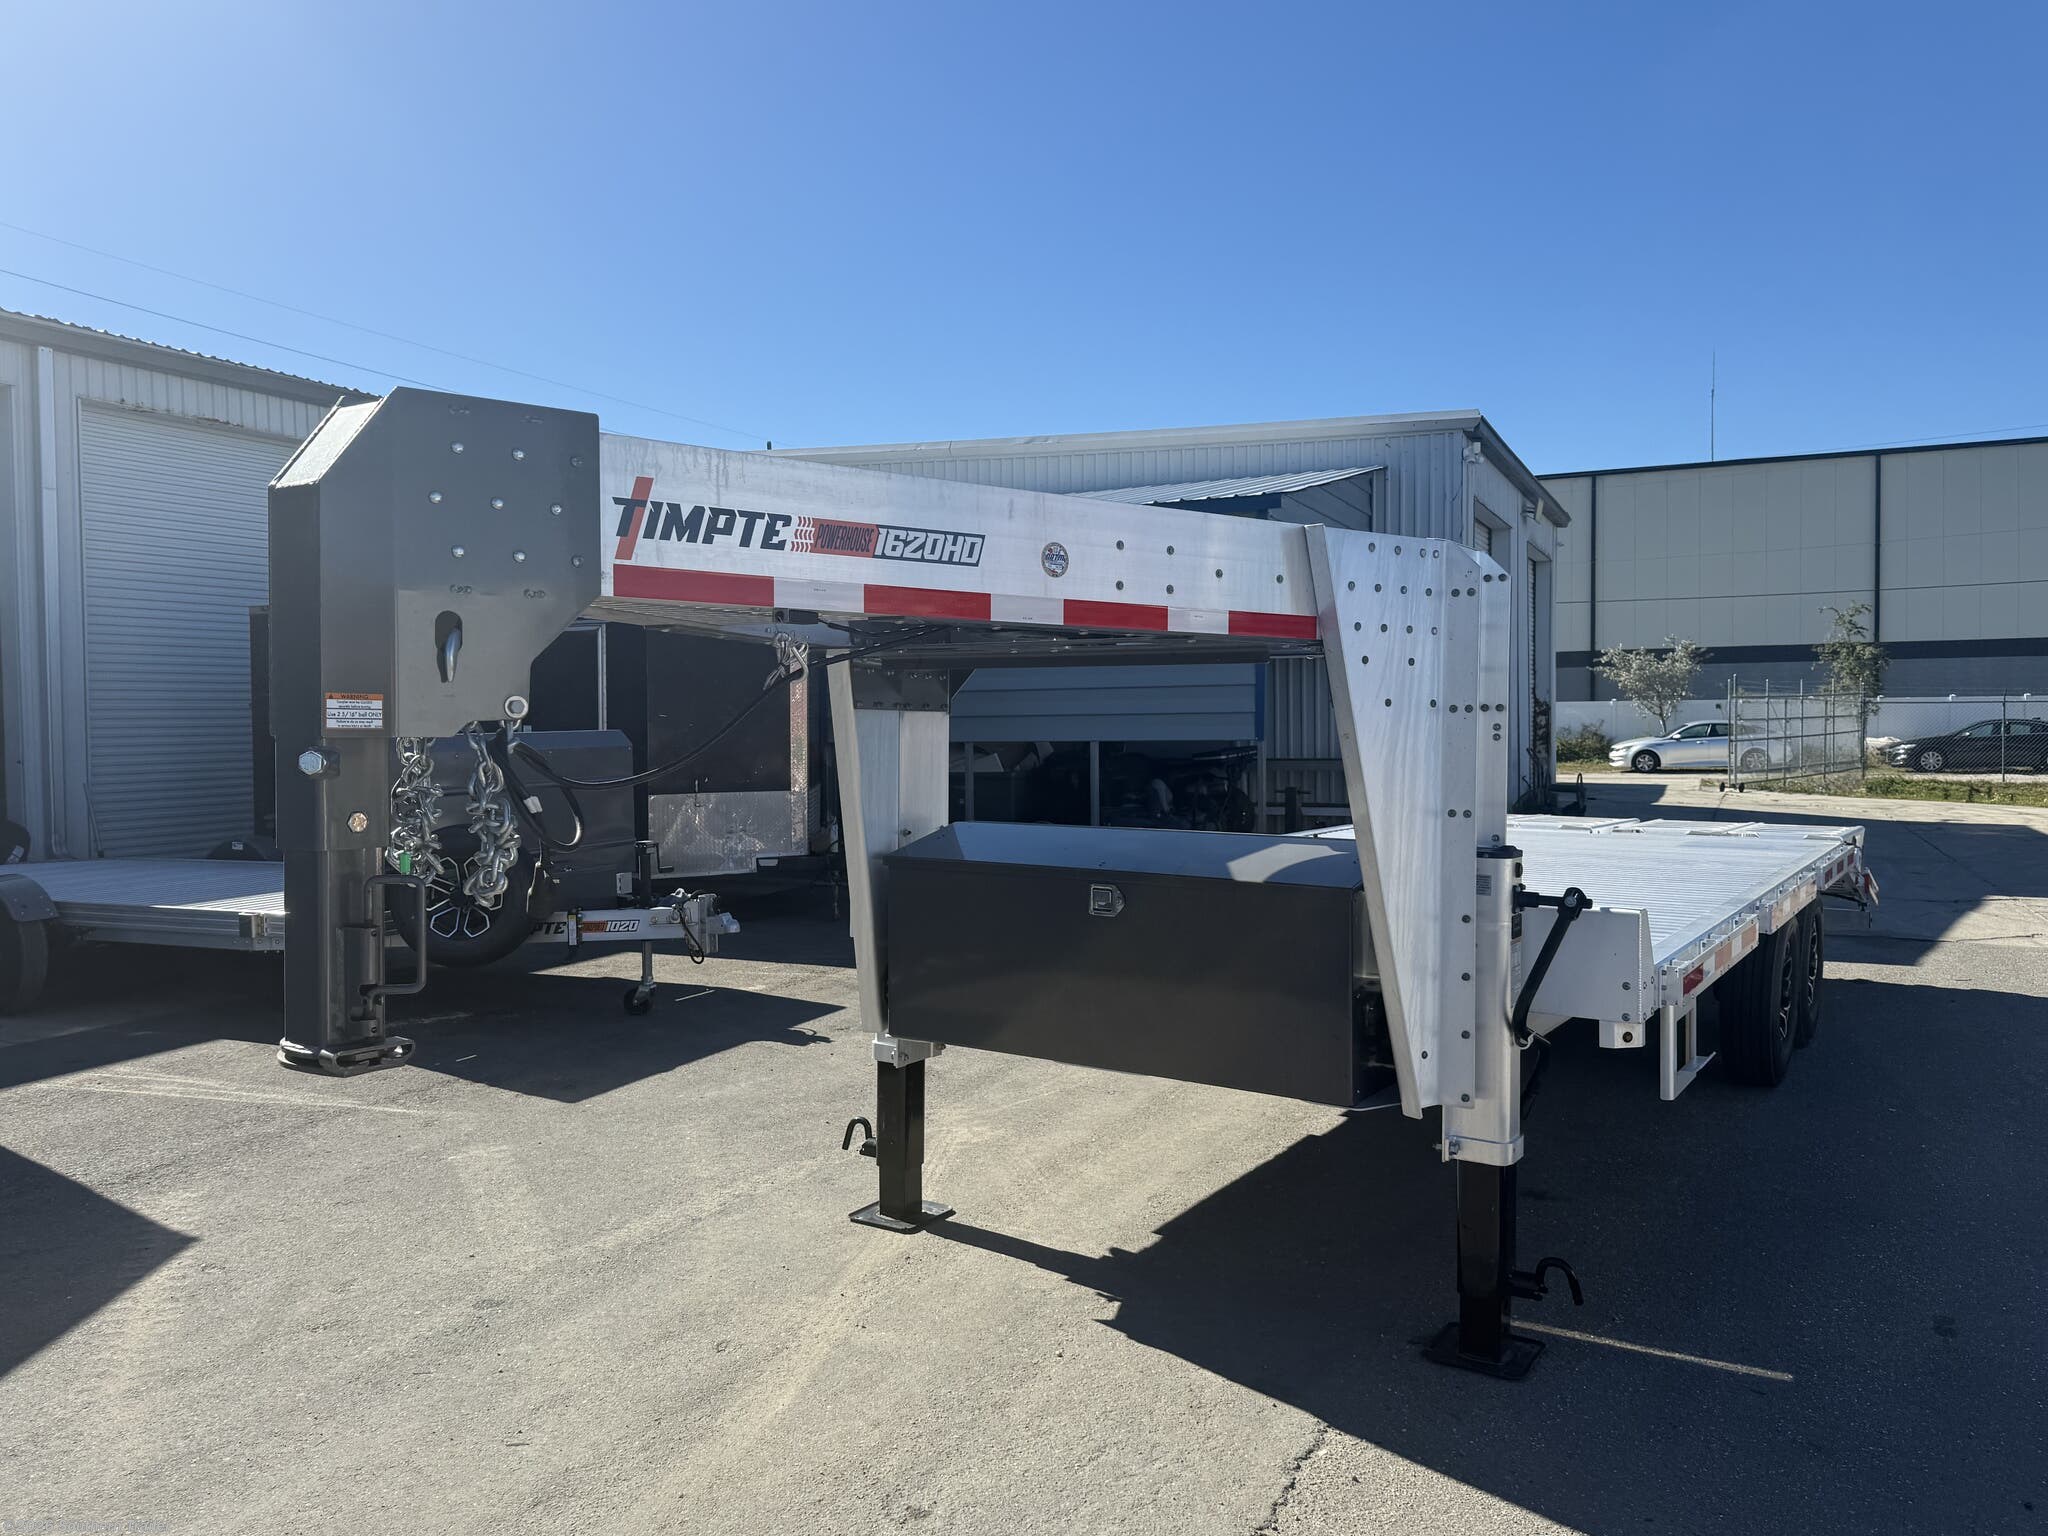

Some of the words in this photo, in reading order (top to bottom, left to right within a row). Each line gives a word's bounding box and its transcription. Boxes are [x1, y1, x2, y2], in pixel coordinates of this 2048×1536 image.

[612, 494, 792, 552] TIMPTE
[815, 523, 876, 554] POWERHOUSE
[874, 526, 983, 565] 1620HD
[605, 920, 639, 932] 1020
